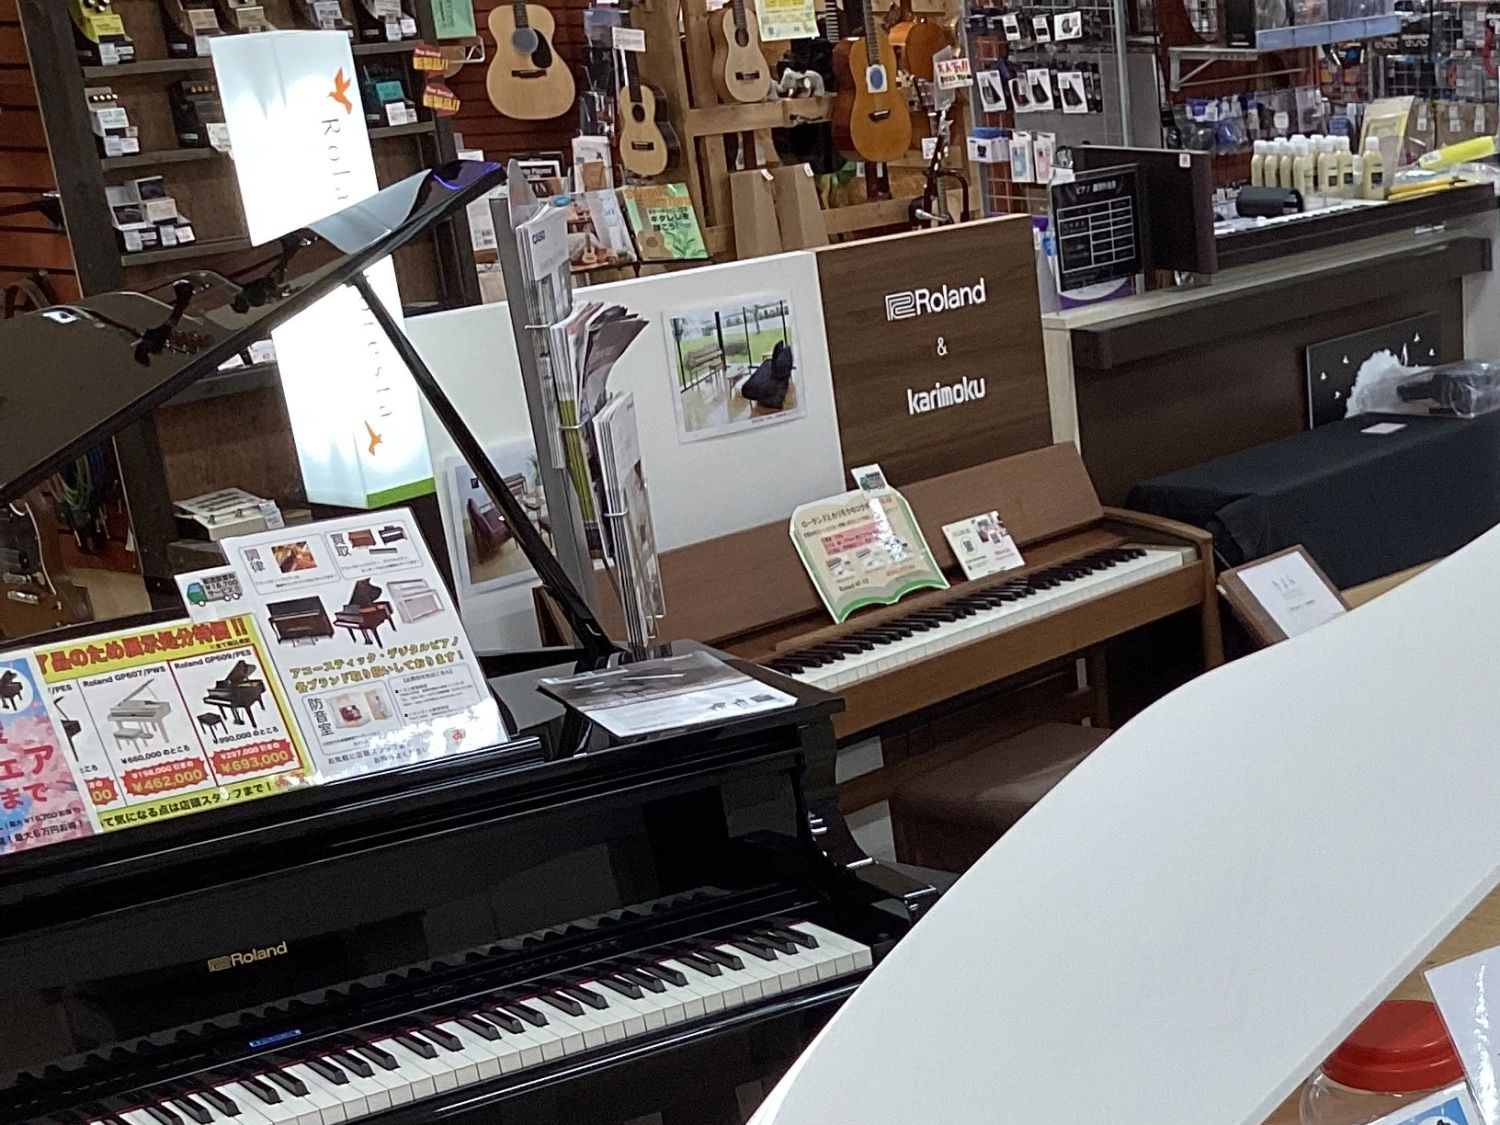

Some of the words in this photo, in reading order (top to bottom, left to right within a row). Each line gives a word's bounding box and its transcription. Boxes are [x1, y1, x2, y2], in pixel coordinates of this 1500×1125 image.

[914, 277, 986, 316] Roland
[936, 336, 949, 357] &
[907, 375, 987, 416] karimoku
[173, 657, 205, 671] Roland
[288, 636, 460, 680] アコースティック・デジタルピアノ
[82, 673, 114, 689] Roland
[113, 664, 167, 685] GP607/PWS
[307, 697, 335, 738] 防音室
[220, 750, 290, 775] ¥693,000
[130, 768, 203, 795] ¥462,000
[100, 781, 274, 829] て気になる点は店頭スタフまで！
[230, 940, 289, 968] Roland
